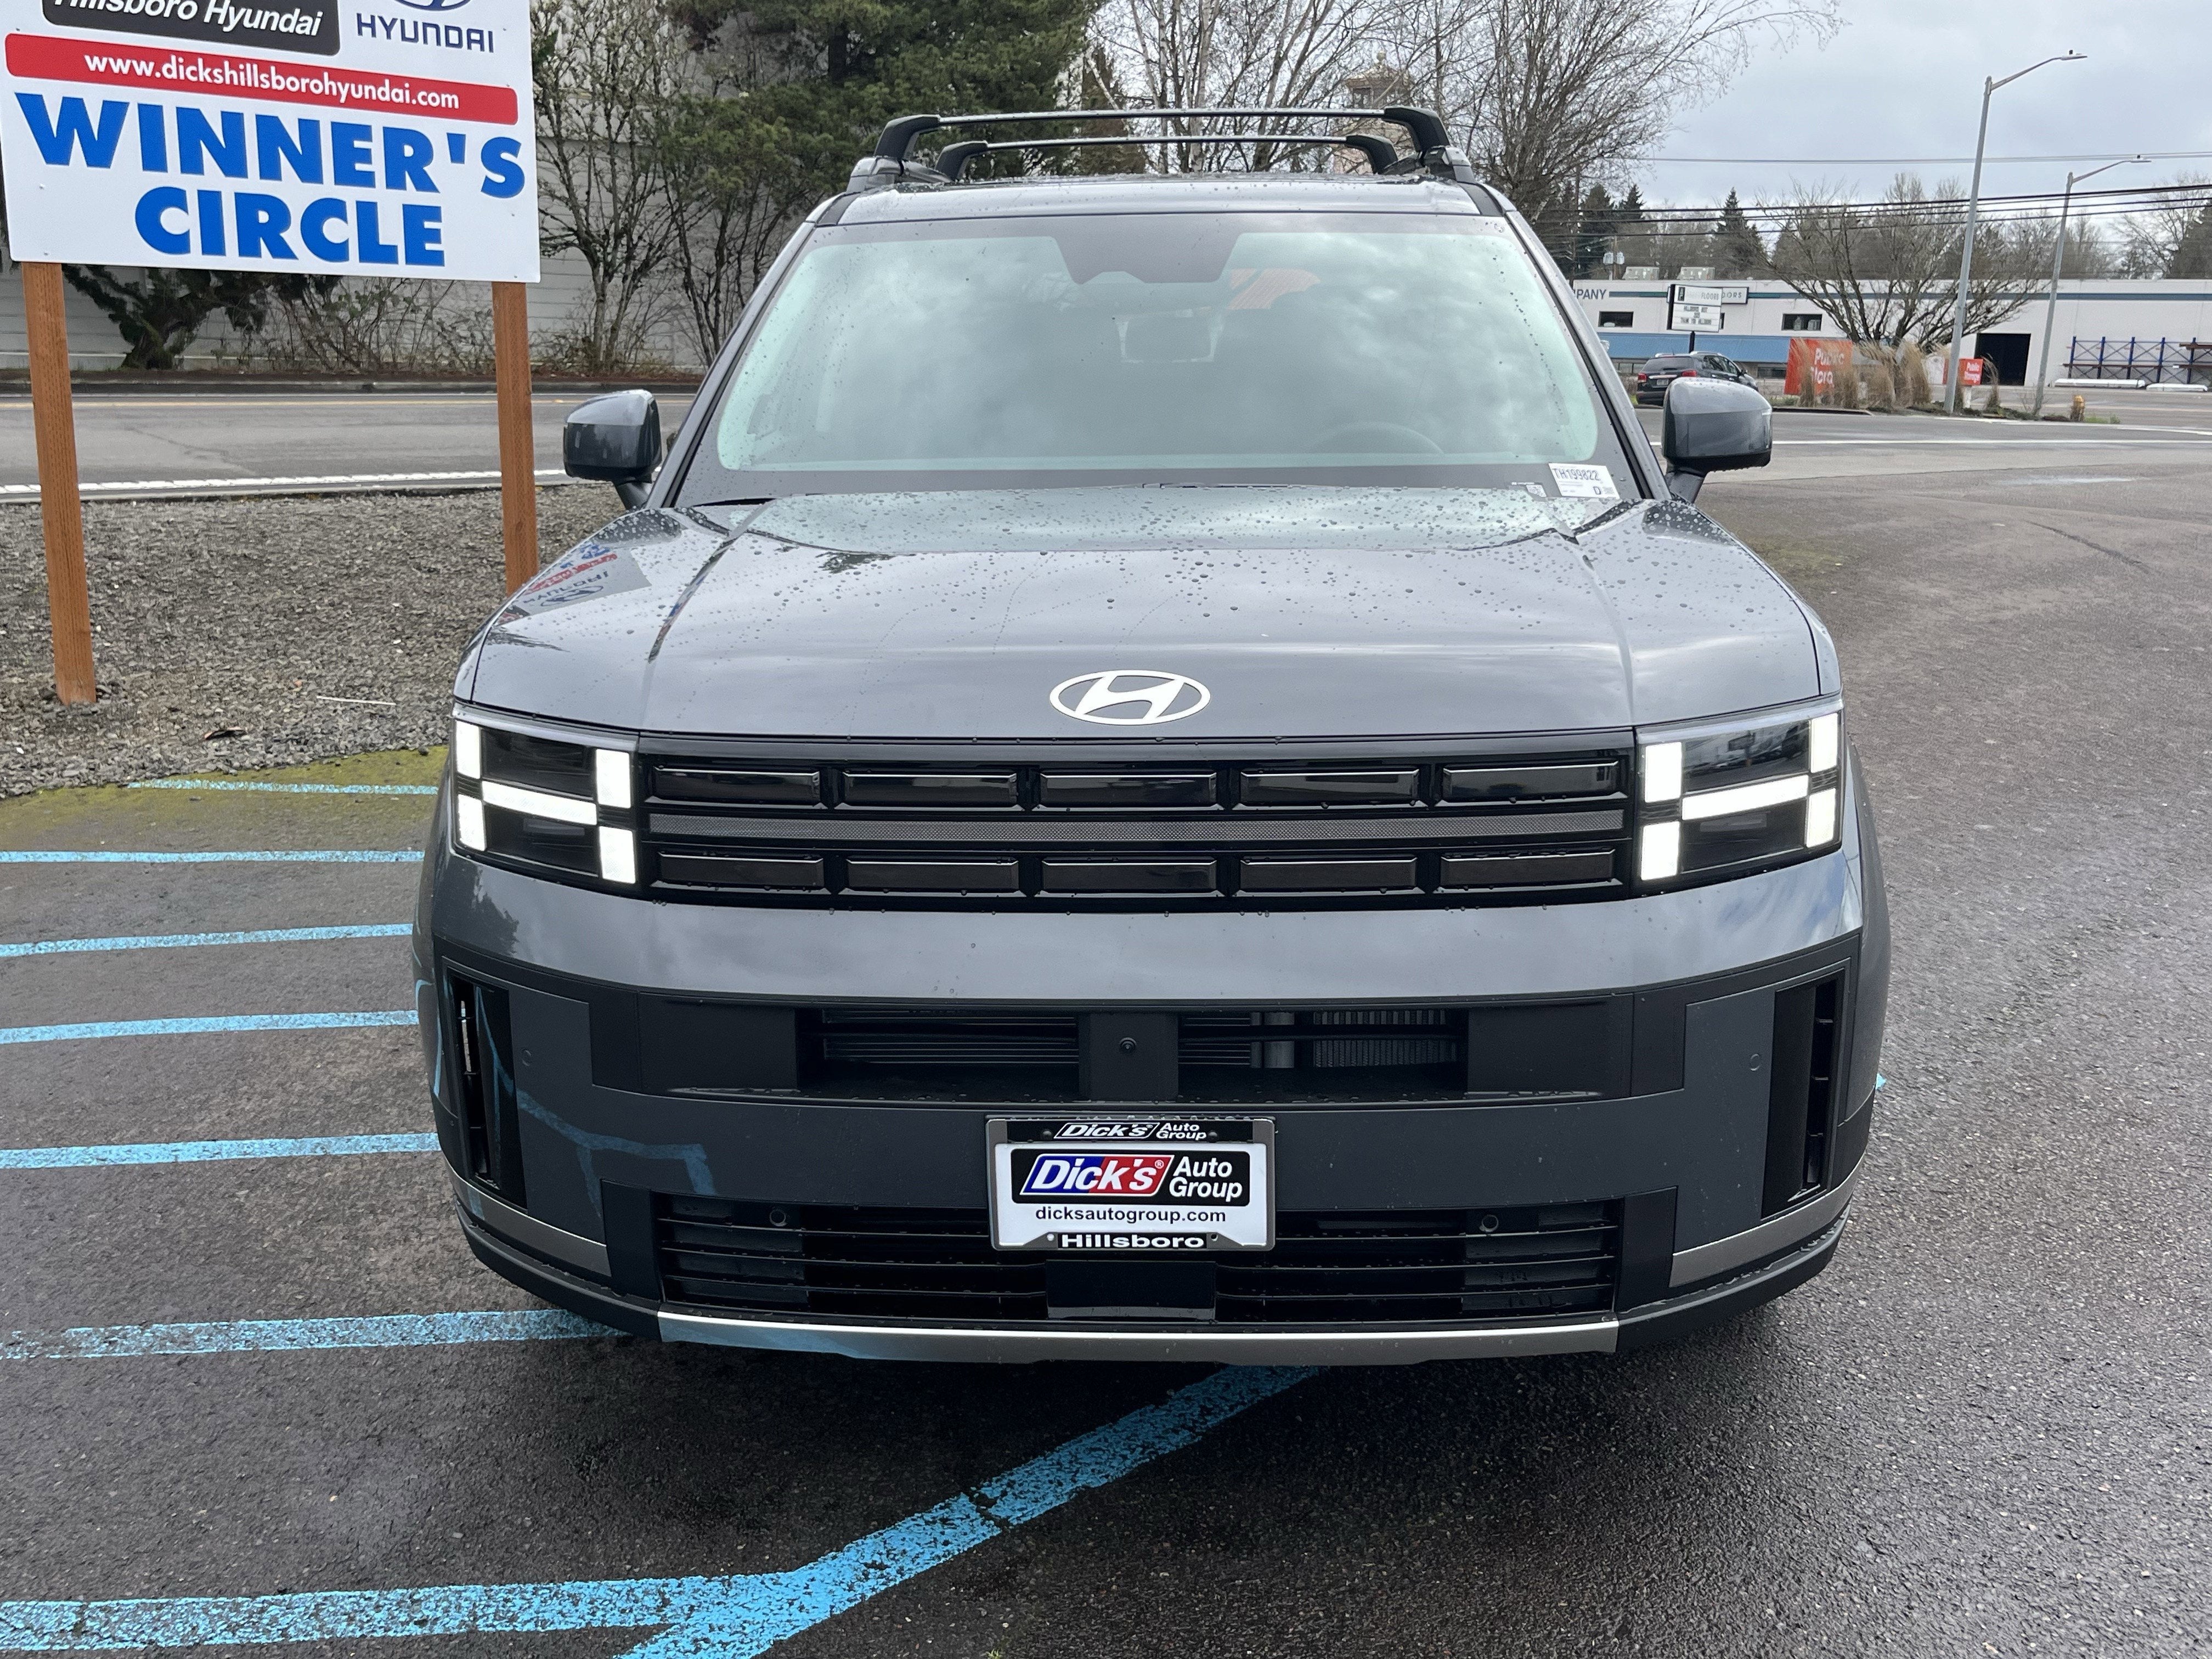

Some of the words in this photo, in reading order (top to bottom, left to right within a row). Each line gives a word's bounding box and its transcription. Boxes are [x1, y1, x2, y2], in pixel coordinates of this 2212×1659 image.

[55, 0, 198, 21] sboro
[204, 0, 323, 37] Hyundai
[356, 13, 494, 53] HYUNDAI
[84, 54, 460, 109] www.dickshillsborohyundai.com
[14, 92, 525, 199] WINNER'S
[135, 186, 445, 267] CIRCLE
[1573, 289, 1606, 300] PANY
[1061, 1124, 1149, 1137] Dick's
[1155, 1130, 1207, 1141] Group
[1160, 1123, 1200, 1131] Auto
[1031, 1158, 1157, 1191] Dick's
[1173, 1156, 1233, 1178] Auto
[1169, 1177, 1243, 1203] Group
[1035, 1206, 1226, 1224] dicksautogroup.com
[1061, 1234, 1205, 1248] Hillsboro
